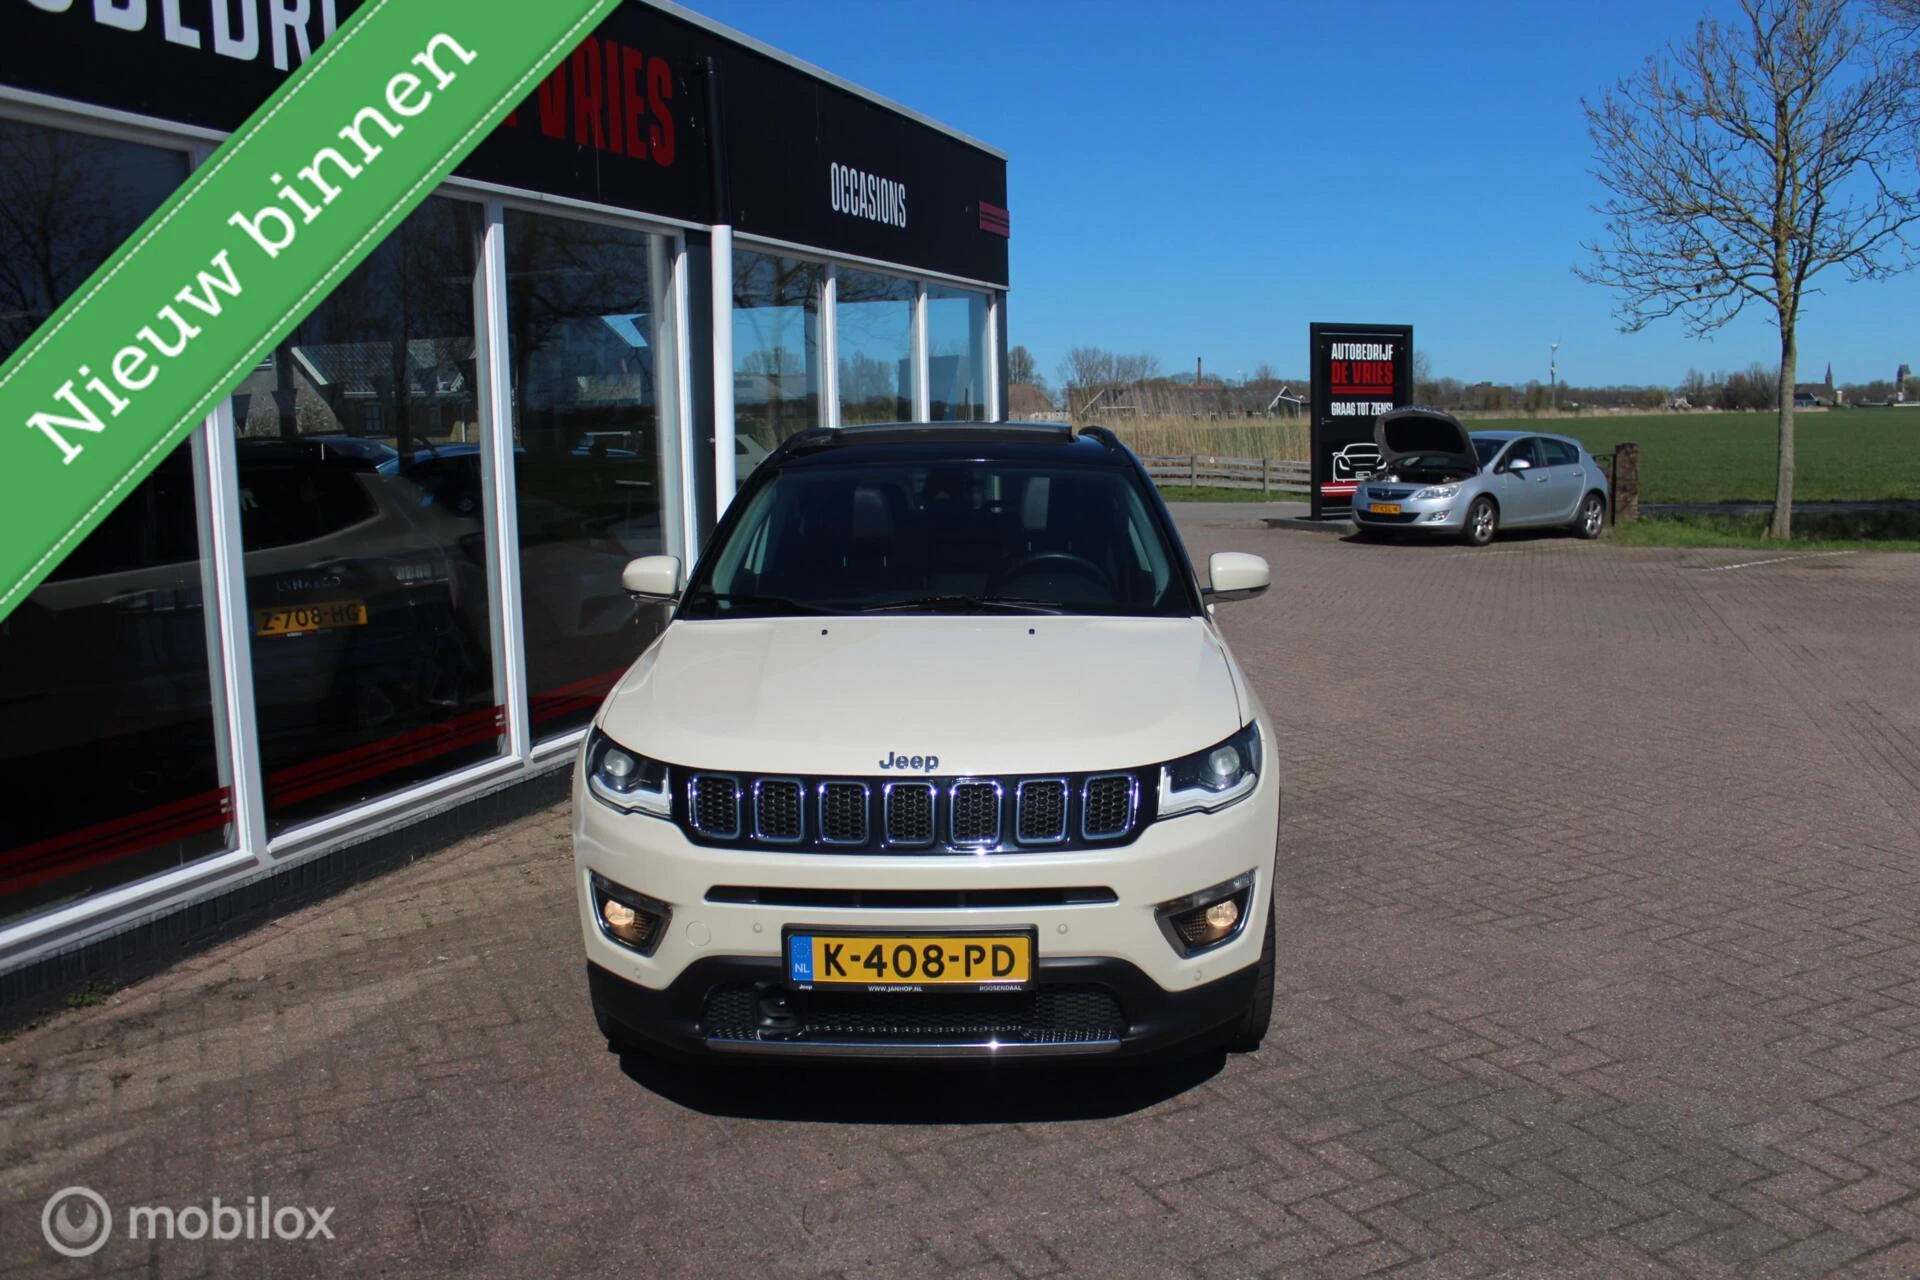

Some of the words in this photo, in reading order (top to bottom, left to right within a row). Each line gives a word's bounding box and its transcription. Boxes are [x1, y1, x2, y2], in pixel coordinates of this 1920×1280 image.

[831, 162, 906, 229] OCCASIONS
[1331, 343, 1394, 361] AUTOBEDRIJF
[1331, 362, 1348, 385] DE
[1352, 361, 1393, 385] VRIES
[1331, 402, 1356, 416] GRAAG
[1357, 402, 1370, 416] TOT
[260, 604, 362, 632] Z-708-HG
[879, 751, 939, 773] Jeep
[794, 962, 810, 974] NL
[823, 943, 1016, 979] K-408-PD
[979, 984, 1022, 992] ROOSENDAAL
